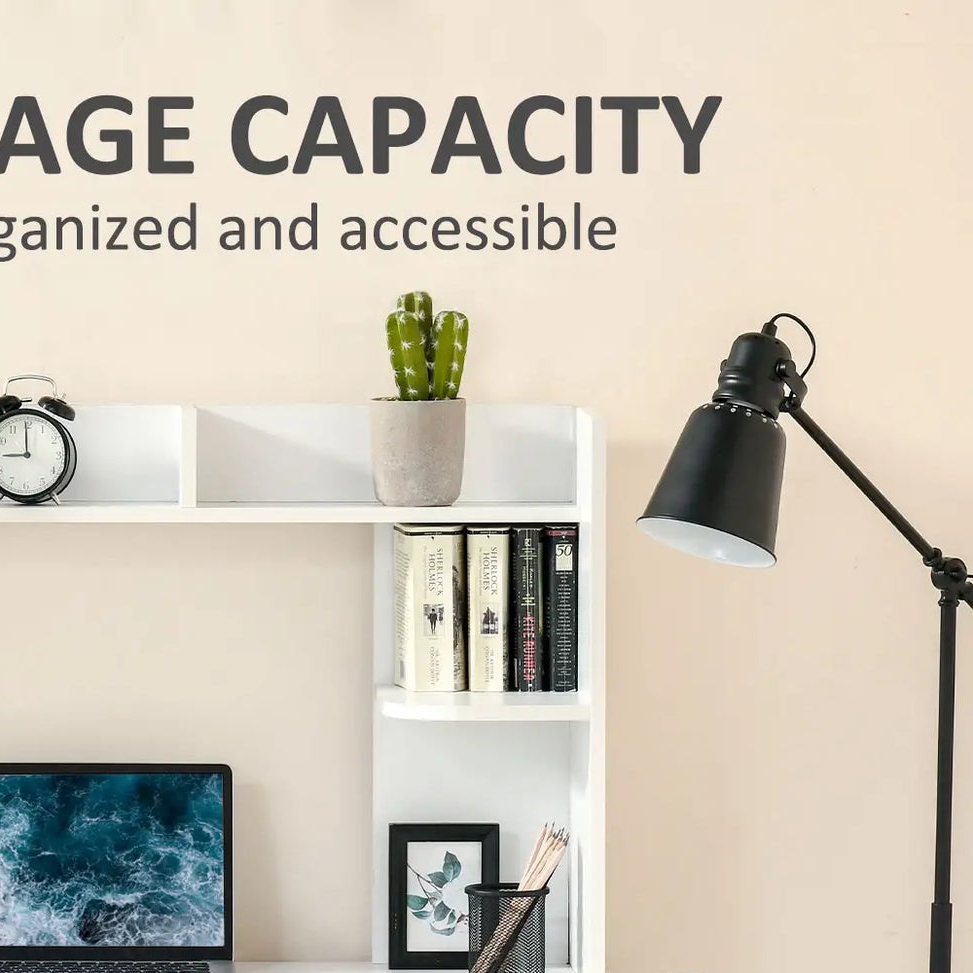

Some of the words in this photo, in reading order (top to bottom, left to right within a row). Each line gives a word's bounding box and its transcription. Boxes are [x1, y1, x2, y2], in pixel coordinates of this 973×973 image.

[555, 545, 572, 556] 50
[490, 547, 498, 596] SHERLOCK
[522, 616, 535, 638] KITE
[522, 640, 535, 681] RUNNER
